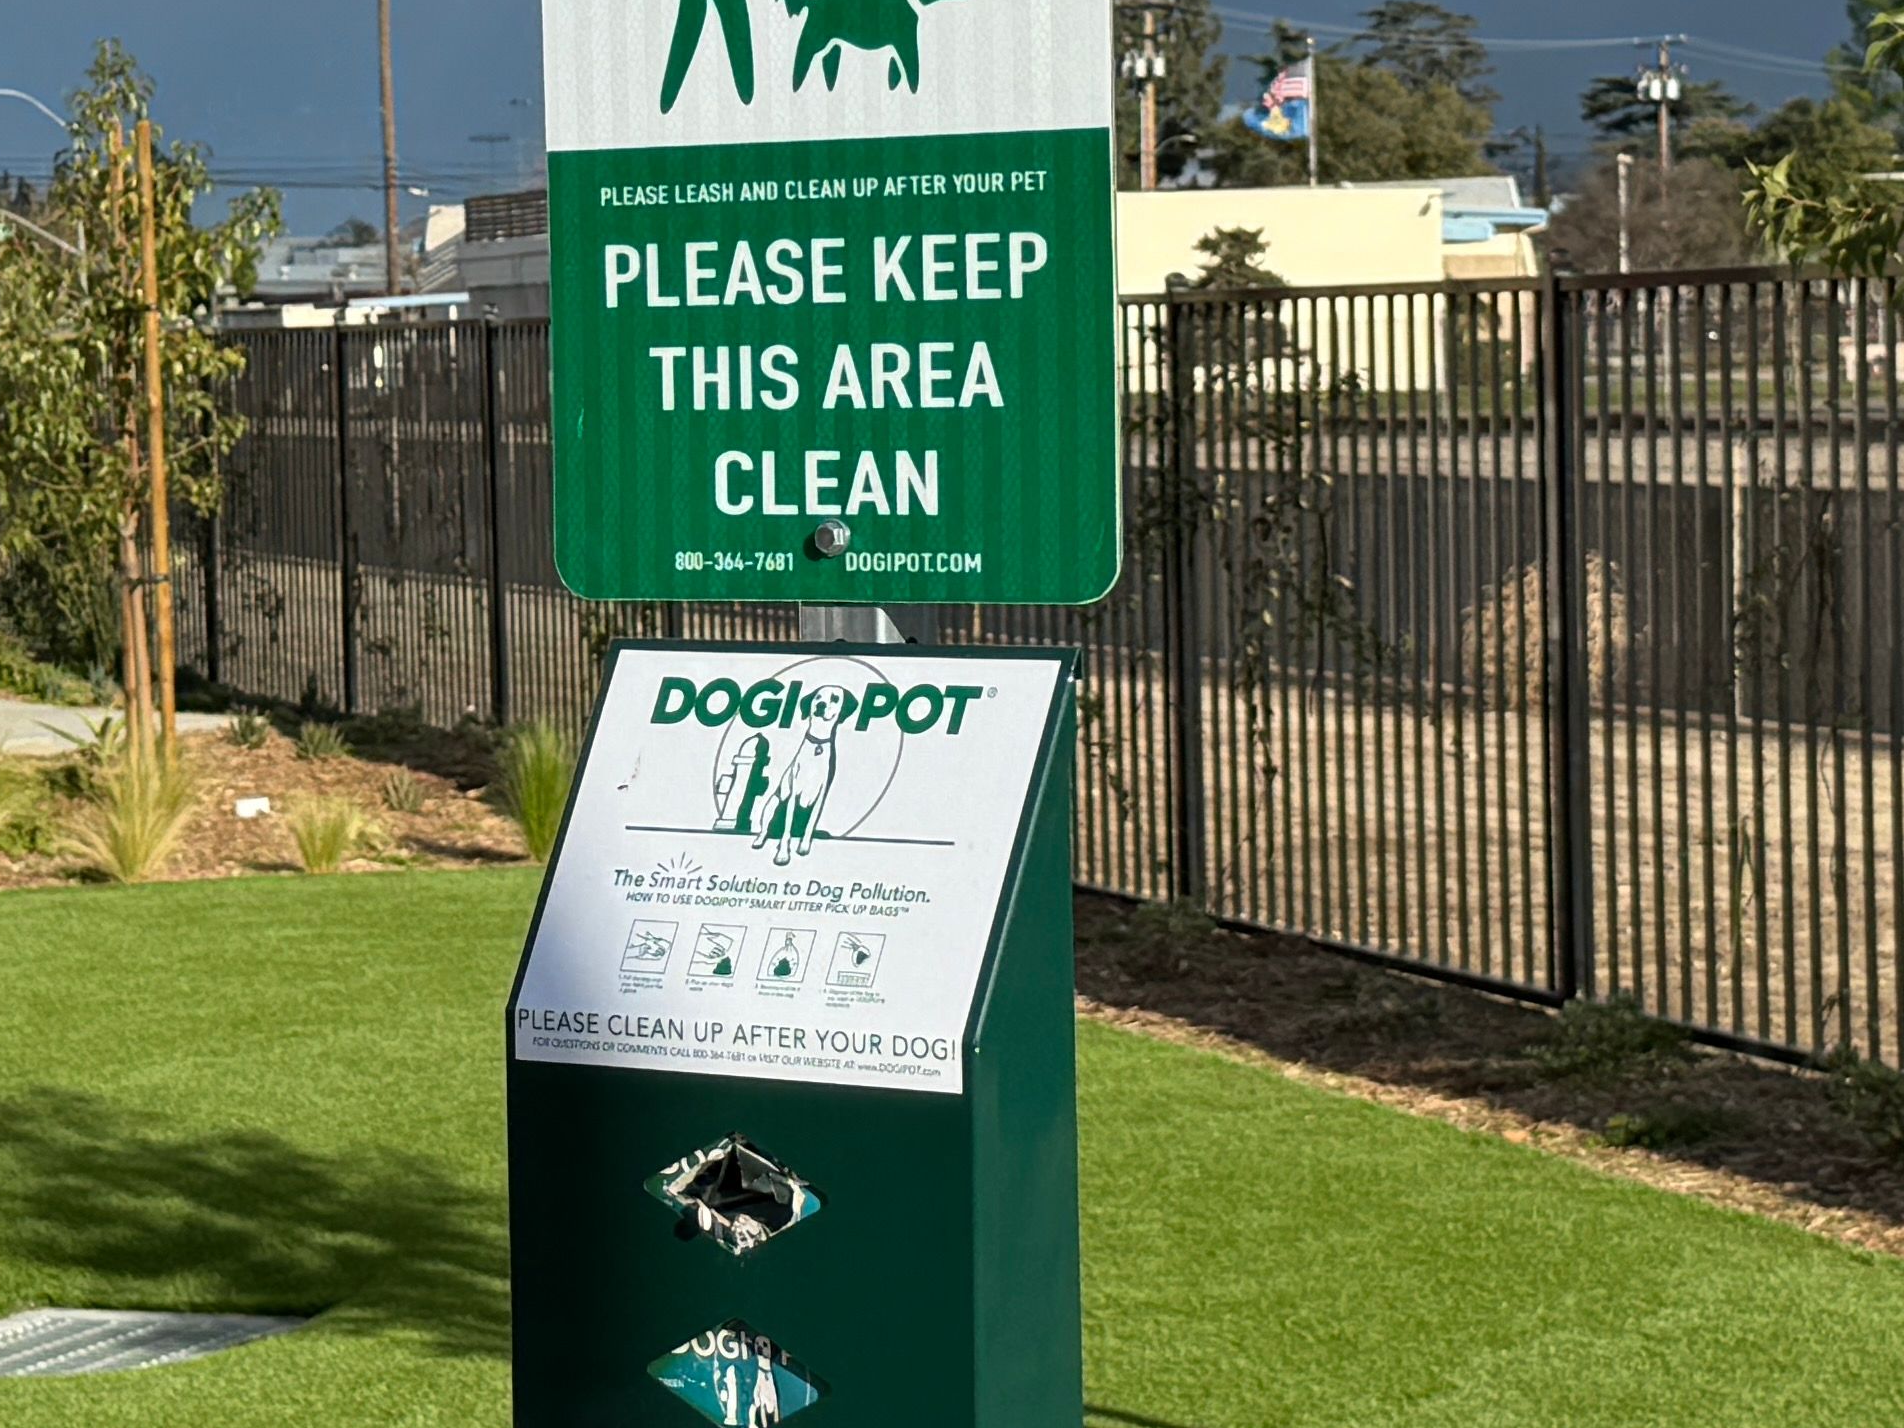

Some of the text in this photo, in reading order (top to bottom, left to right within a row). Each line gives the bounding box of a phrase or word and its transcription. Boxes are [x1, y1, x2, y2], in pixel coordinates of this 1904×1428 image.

[600, 170, 1047, 207] PLEASE LEASH AND CLEAN UP AFTER YOUR PET
[604, 231, 1048, 309] PLEASE KEEP
[648, 341, 1005, 411] THIS AREA
[714, 449, 939, 516] CLEAN
[674, 551, 982, 573] 800-364-7681 DOGIPOT.COM
[613, 868, 931, 904] The Smart Solution to Dog Pollution.
[625, 891, 654, 903] HOW
[656, 892, 671, 904] TO
[672, 894, 694, 905] USE
[749, 897, 786, 910] SMART
[788, 900, 823, 913] LITTER
[825, 902, 850, 914] PICK
[517, 1008, 956, 1061] PLEASE CLEAN UP AFTER YOUR DOG!
